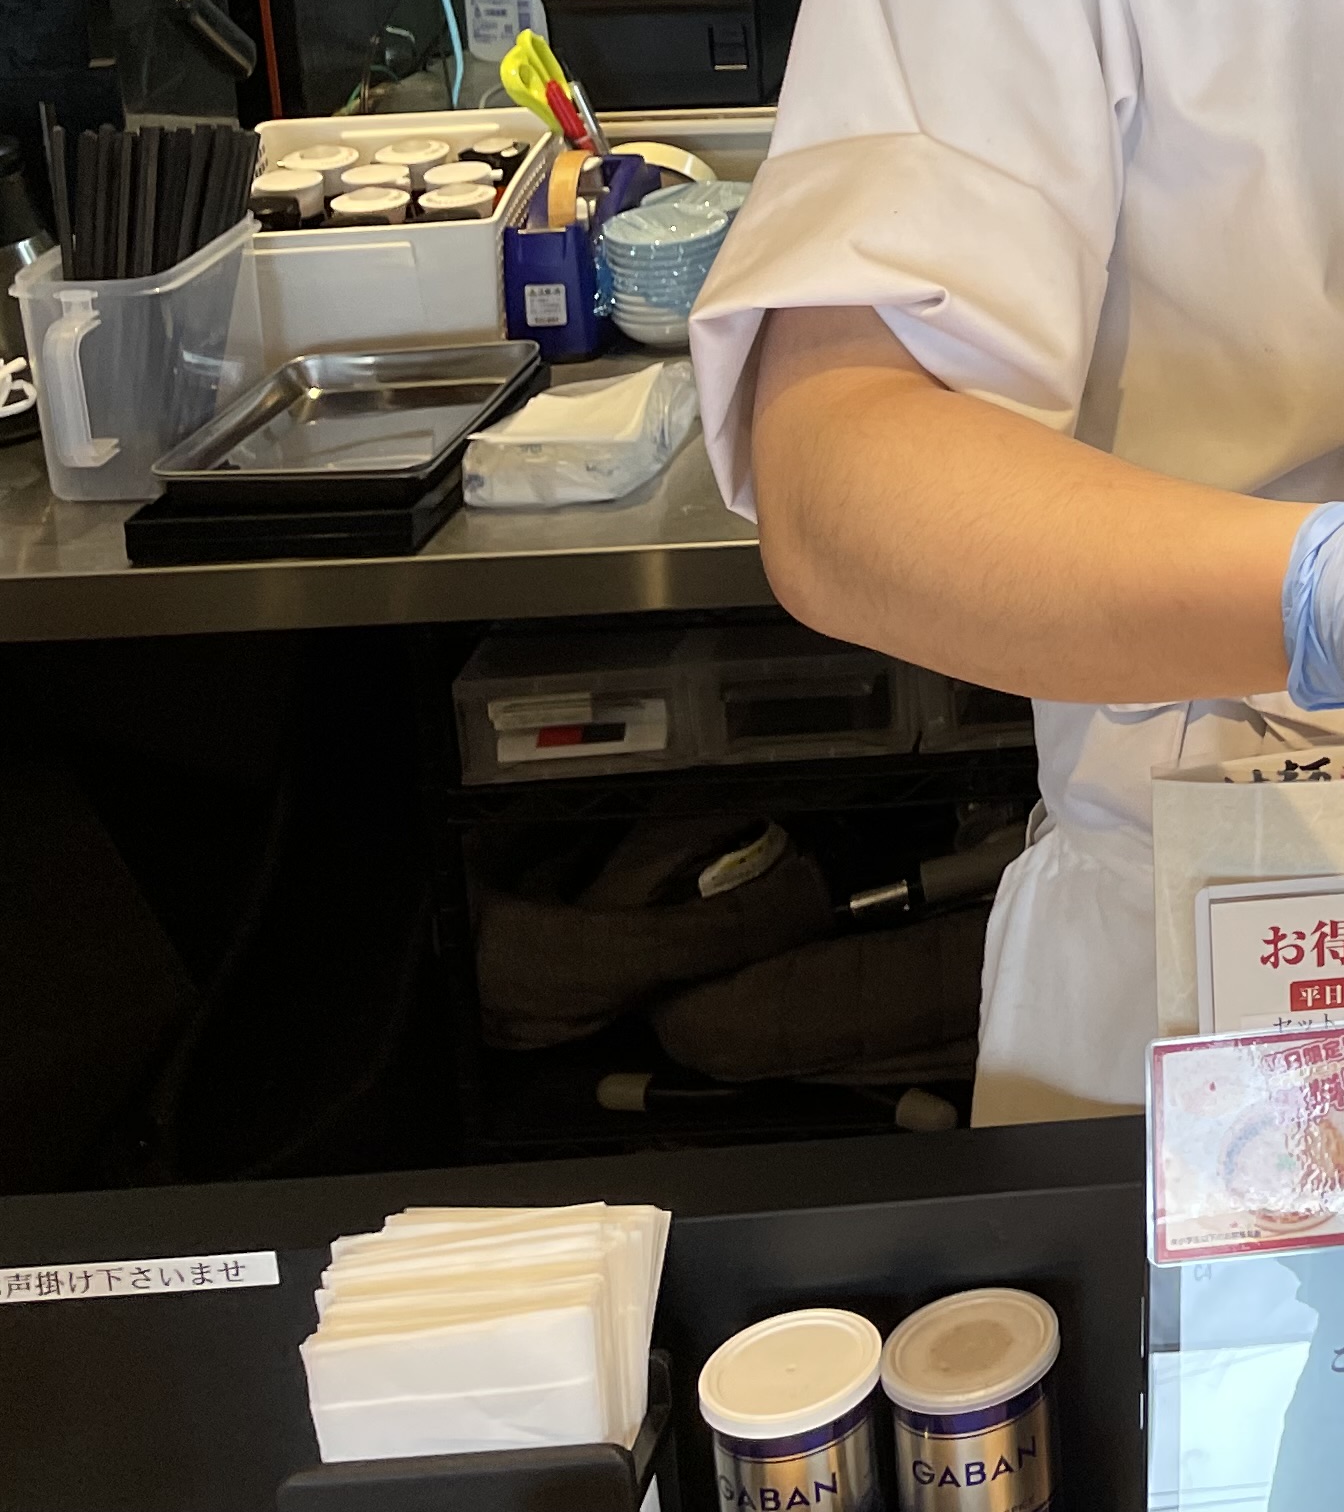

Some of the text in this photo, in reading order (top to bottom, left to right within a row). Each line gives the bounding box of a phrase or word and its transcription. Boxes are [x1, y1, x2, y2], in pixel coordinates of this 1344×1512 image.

[0, 1260, 246, 1299] 声掛け下さいませ
[912, 1435, 1037, 1488] GABAN
